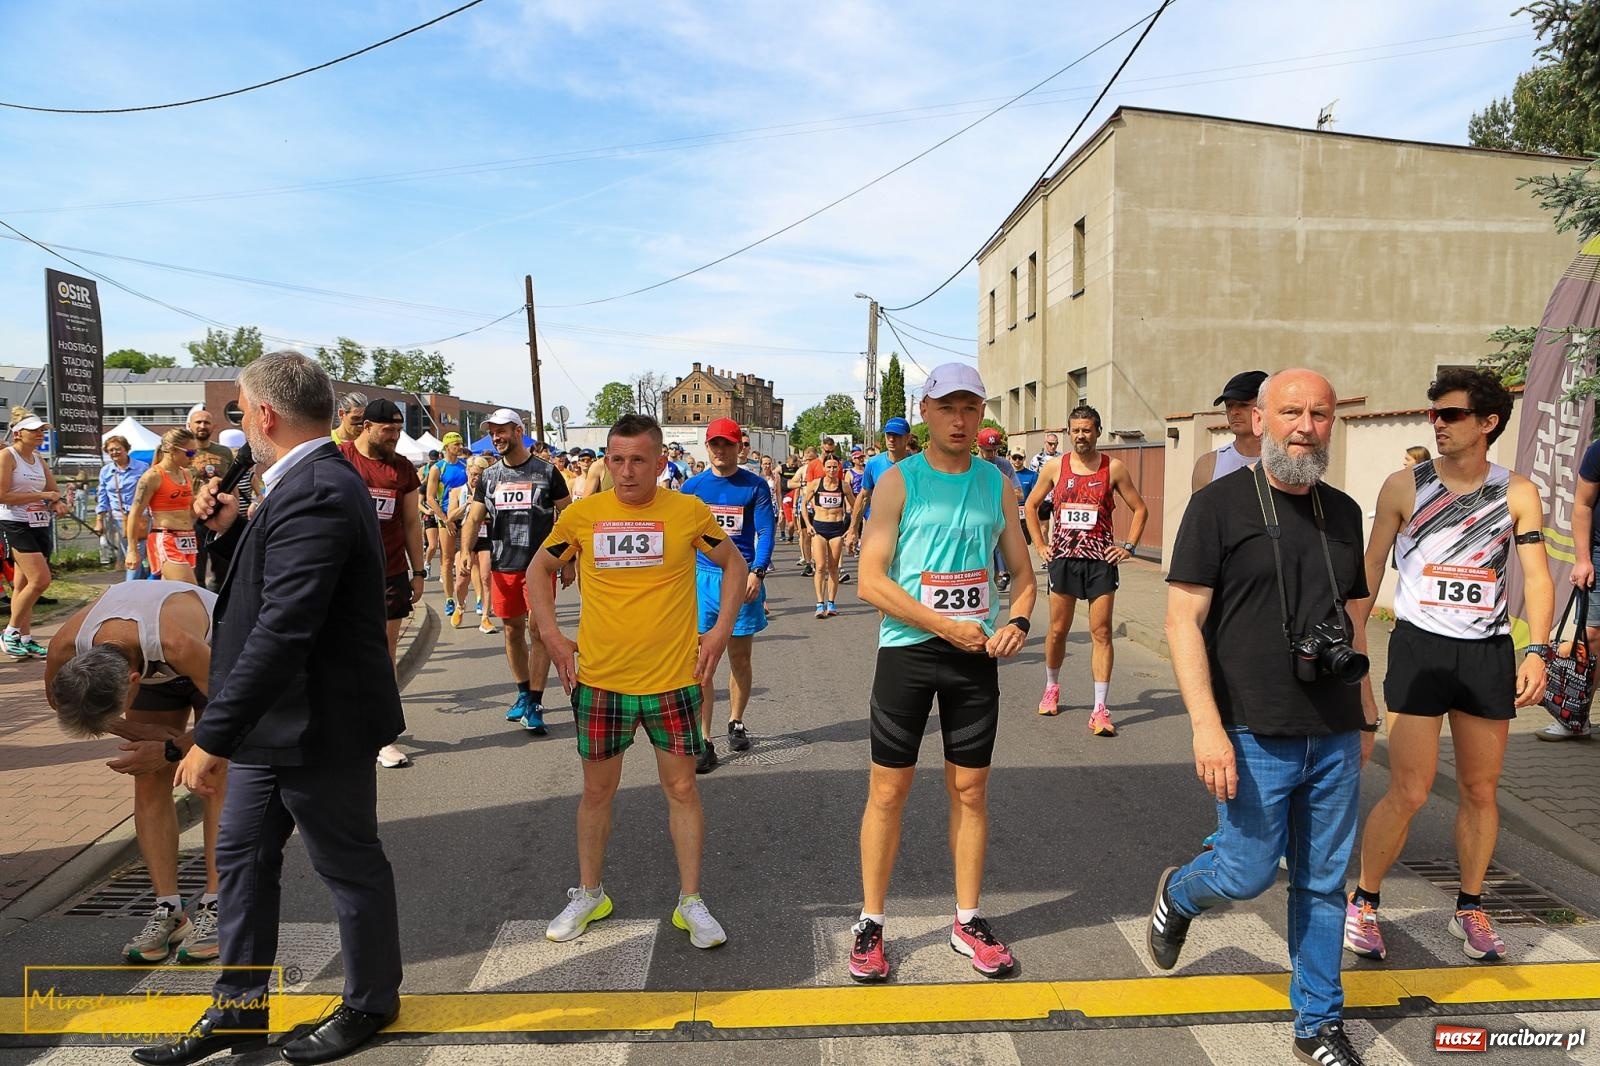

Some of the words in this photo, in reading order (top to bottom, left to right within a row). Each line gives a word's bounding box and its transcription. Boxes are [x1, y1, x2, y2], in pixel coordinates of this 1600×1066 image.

[62, 356, 95, 368] STADION
[65, 368, 92, 378] MIEJSKI
[67, 383, 92, 393] KORTY
[60, 392, 97, 404] TENISOWE
[59, 408, 99, 419] KRĘGIELNIA
[60, 423, 99, 433] SKATEPARK
[503, 491, 524, 503] 170
[1067, 511, 1090, 522] 138
[607, 533, 650, 555] 143
[933, 586, 981, 610] 238
[1437, 580, 1482, 604] 136
